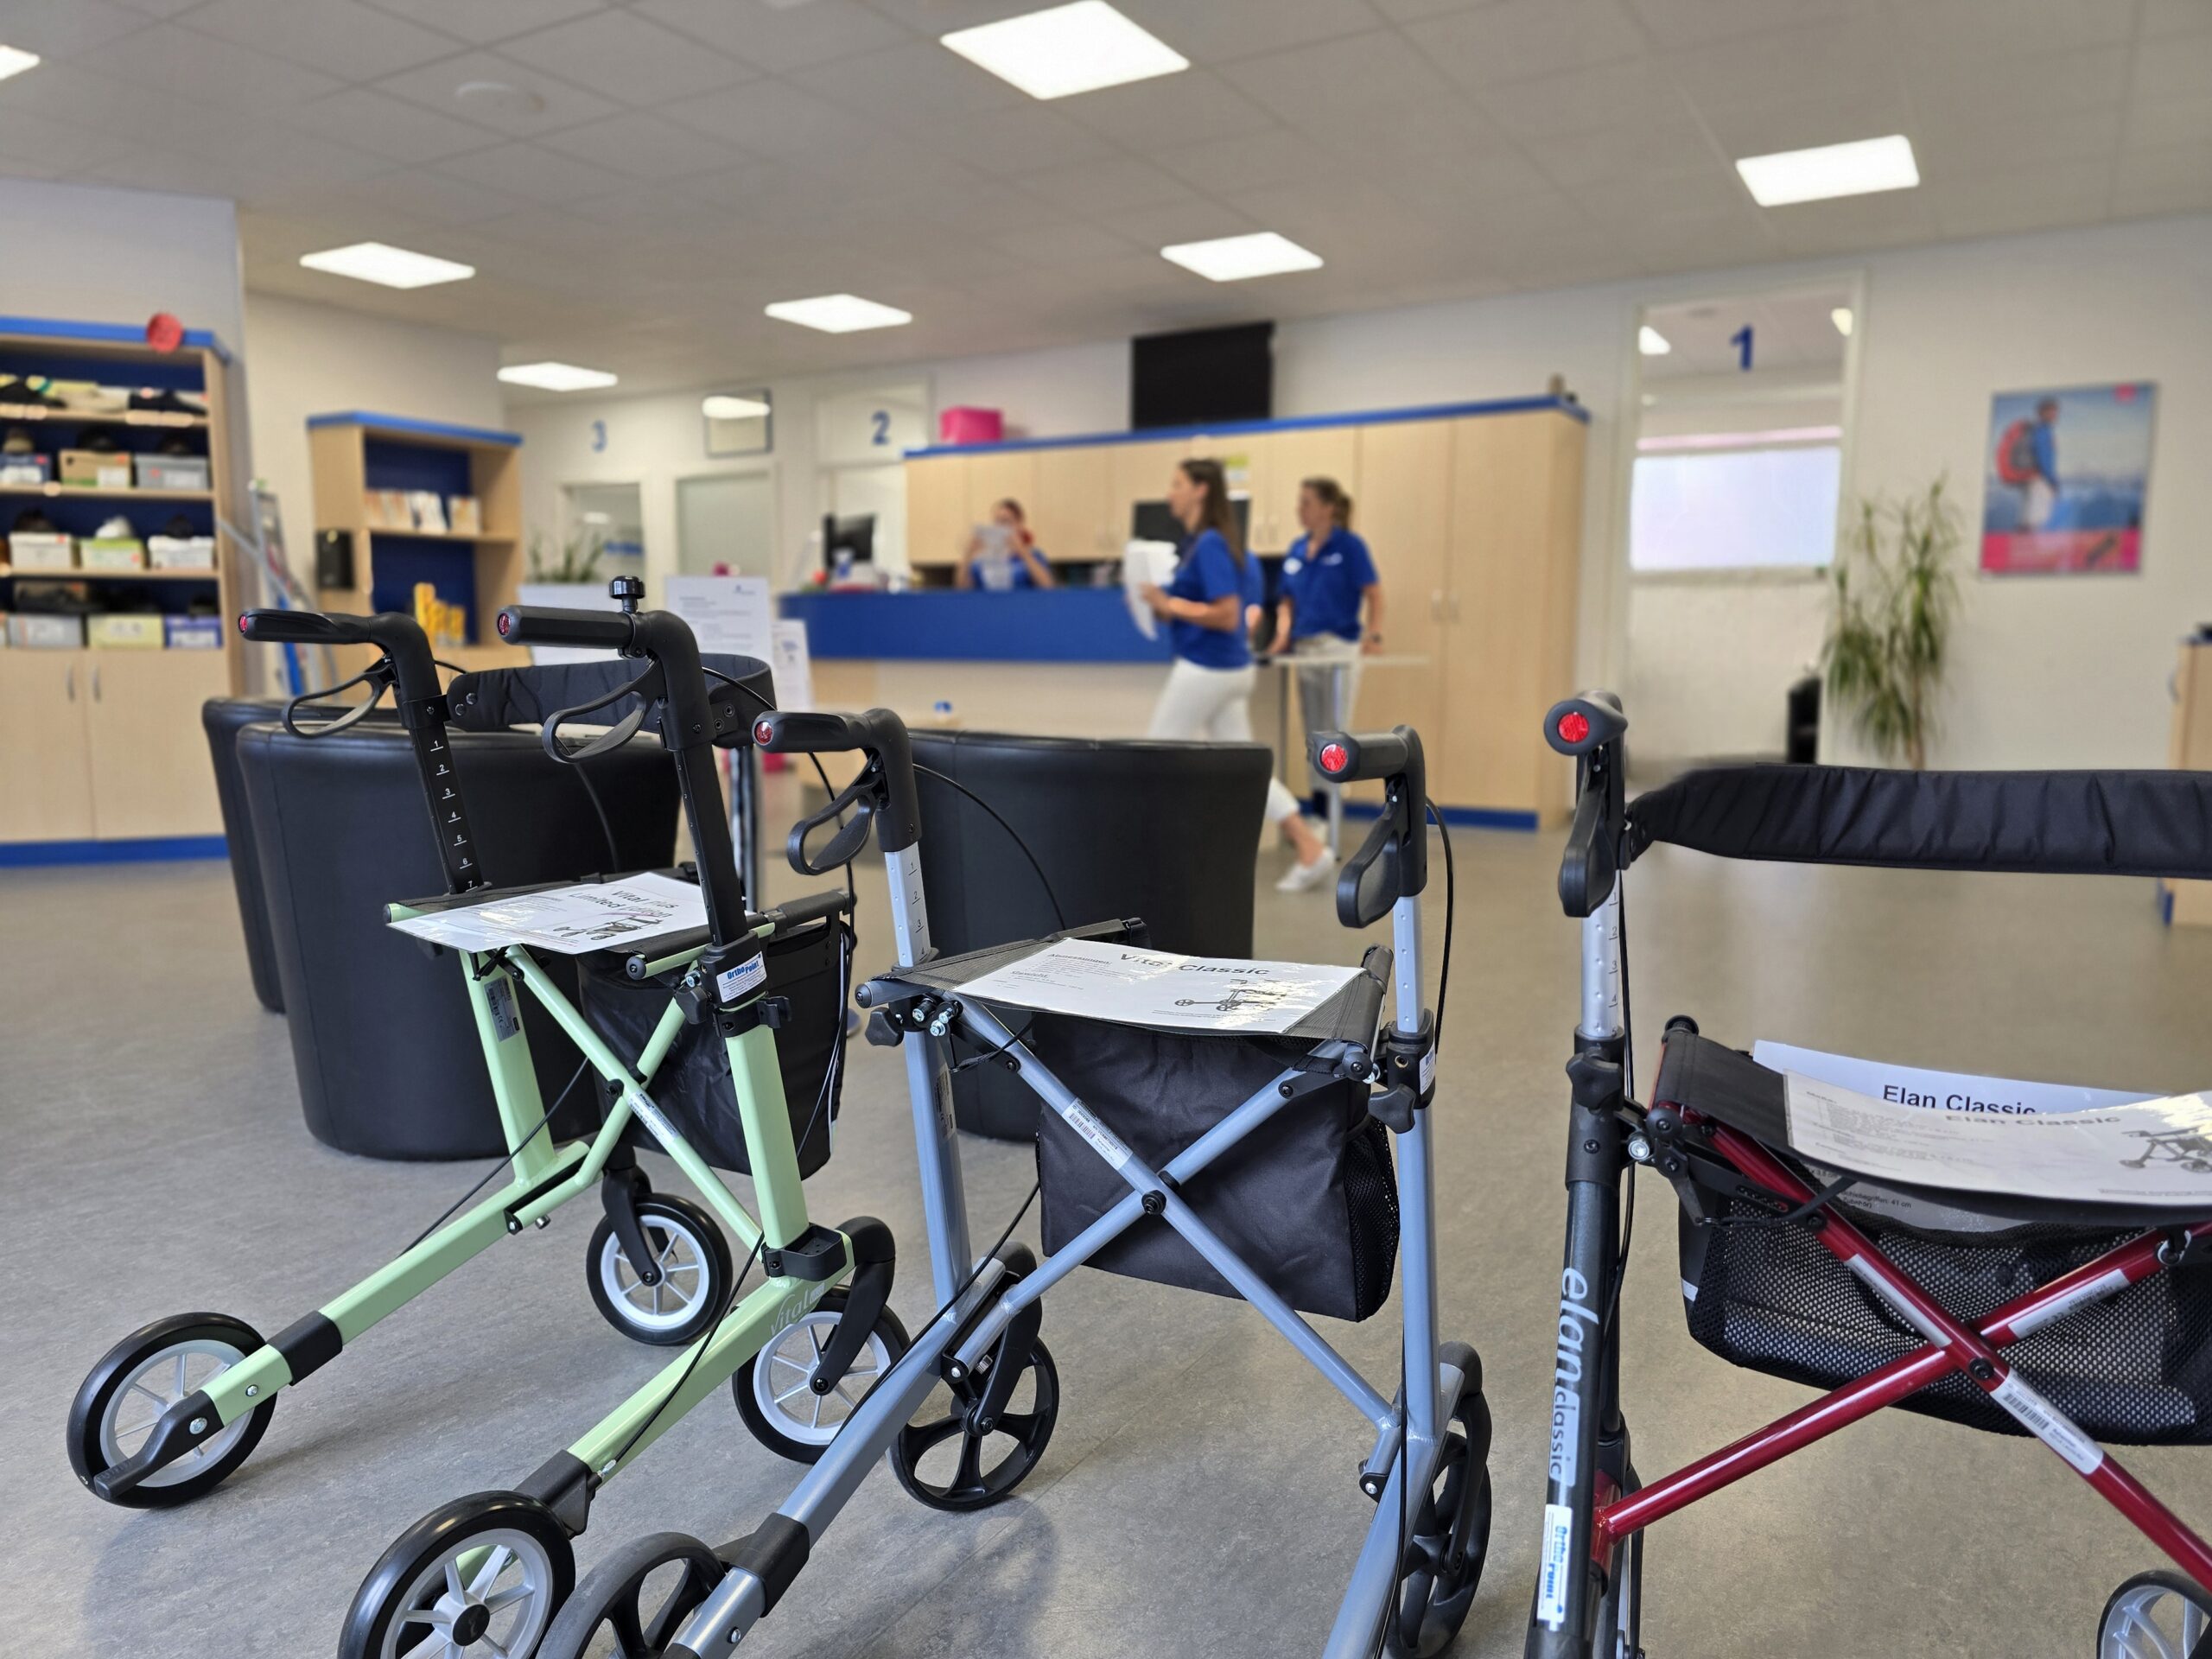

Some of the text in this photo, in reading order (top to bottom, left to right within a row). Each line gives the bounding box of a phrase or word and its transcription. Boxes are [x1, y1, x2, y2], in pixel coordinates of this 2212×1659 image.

[1730, 325, 1754, 372] 1
[872, 410, 891, 446] 2
[592, 420, 607, 453] 3
[569, 893, 626, 908] Limited
[611, 890, 650, 903] Vital
[913, 891, 918, 899] 2
[1612, 927, 1618, 936] 2
[1121, 953, 1271, 976] Vita Classic
[1612, 961, 1618, 970] 3
[1611, 995, 1618, 1003] 4
[1883, 1084, 1936, 1109] Elan
[1945, 1115, 2121, 1126] Elan Classic
[1549, 1267, 1599, 1475] elan classic
